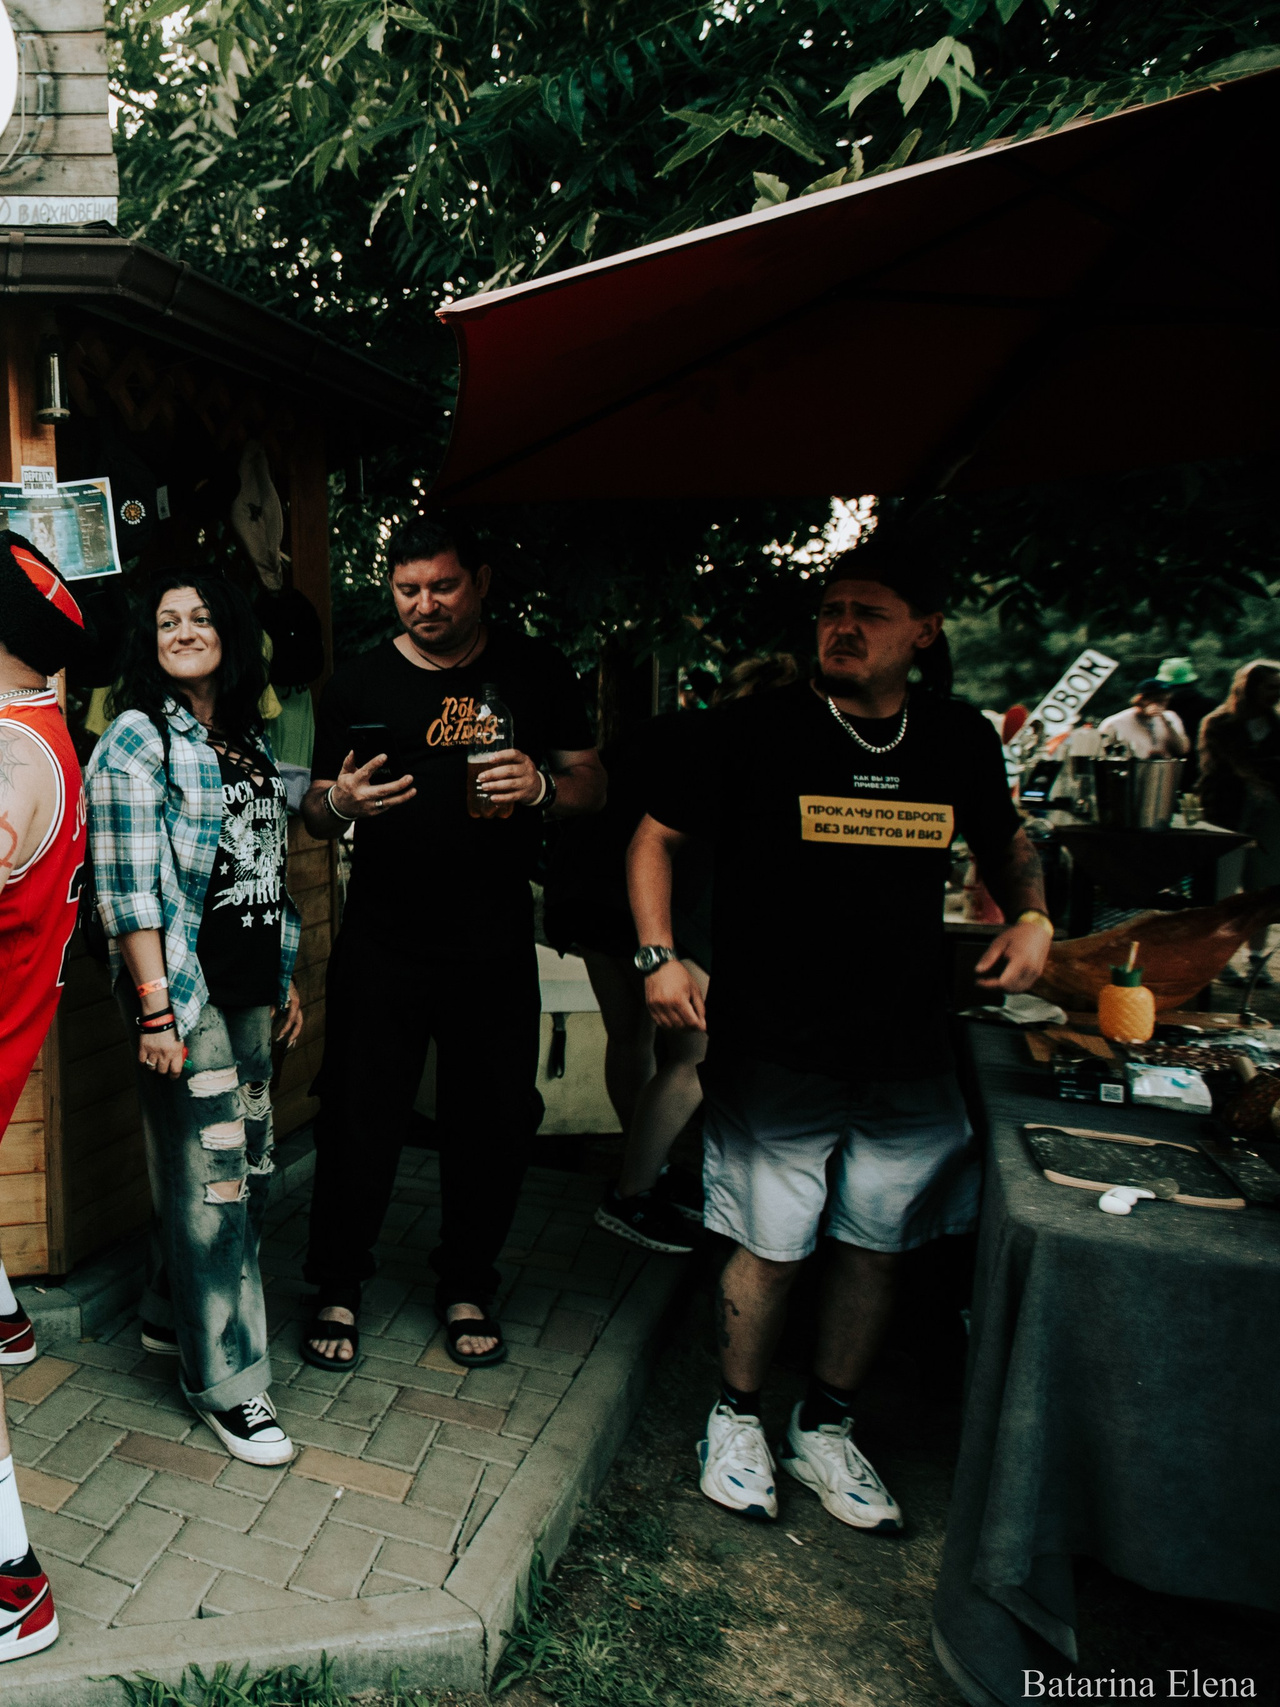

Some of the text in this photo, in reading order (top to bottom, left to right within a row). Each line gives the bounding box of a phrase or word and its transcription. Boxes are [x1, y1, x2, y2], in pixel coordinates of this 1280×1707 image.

[221, 780, 255, 804] OCK
[807, 805, 946, 823] ПРОКАЧУ ПО ЕВРОПЕ
[814, 823, 943, 841] БЕЗ БИЛЕТОВ И ВИЗ
